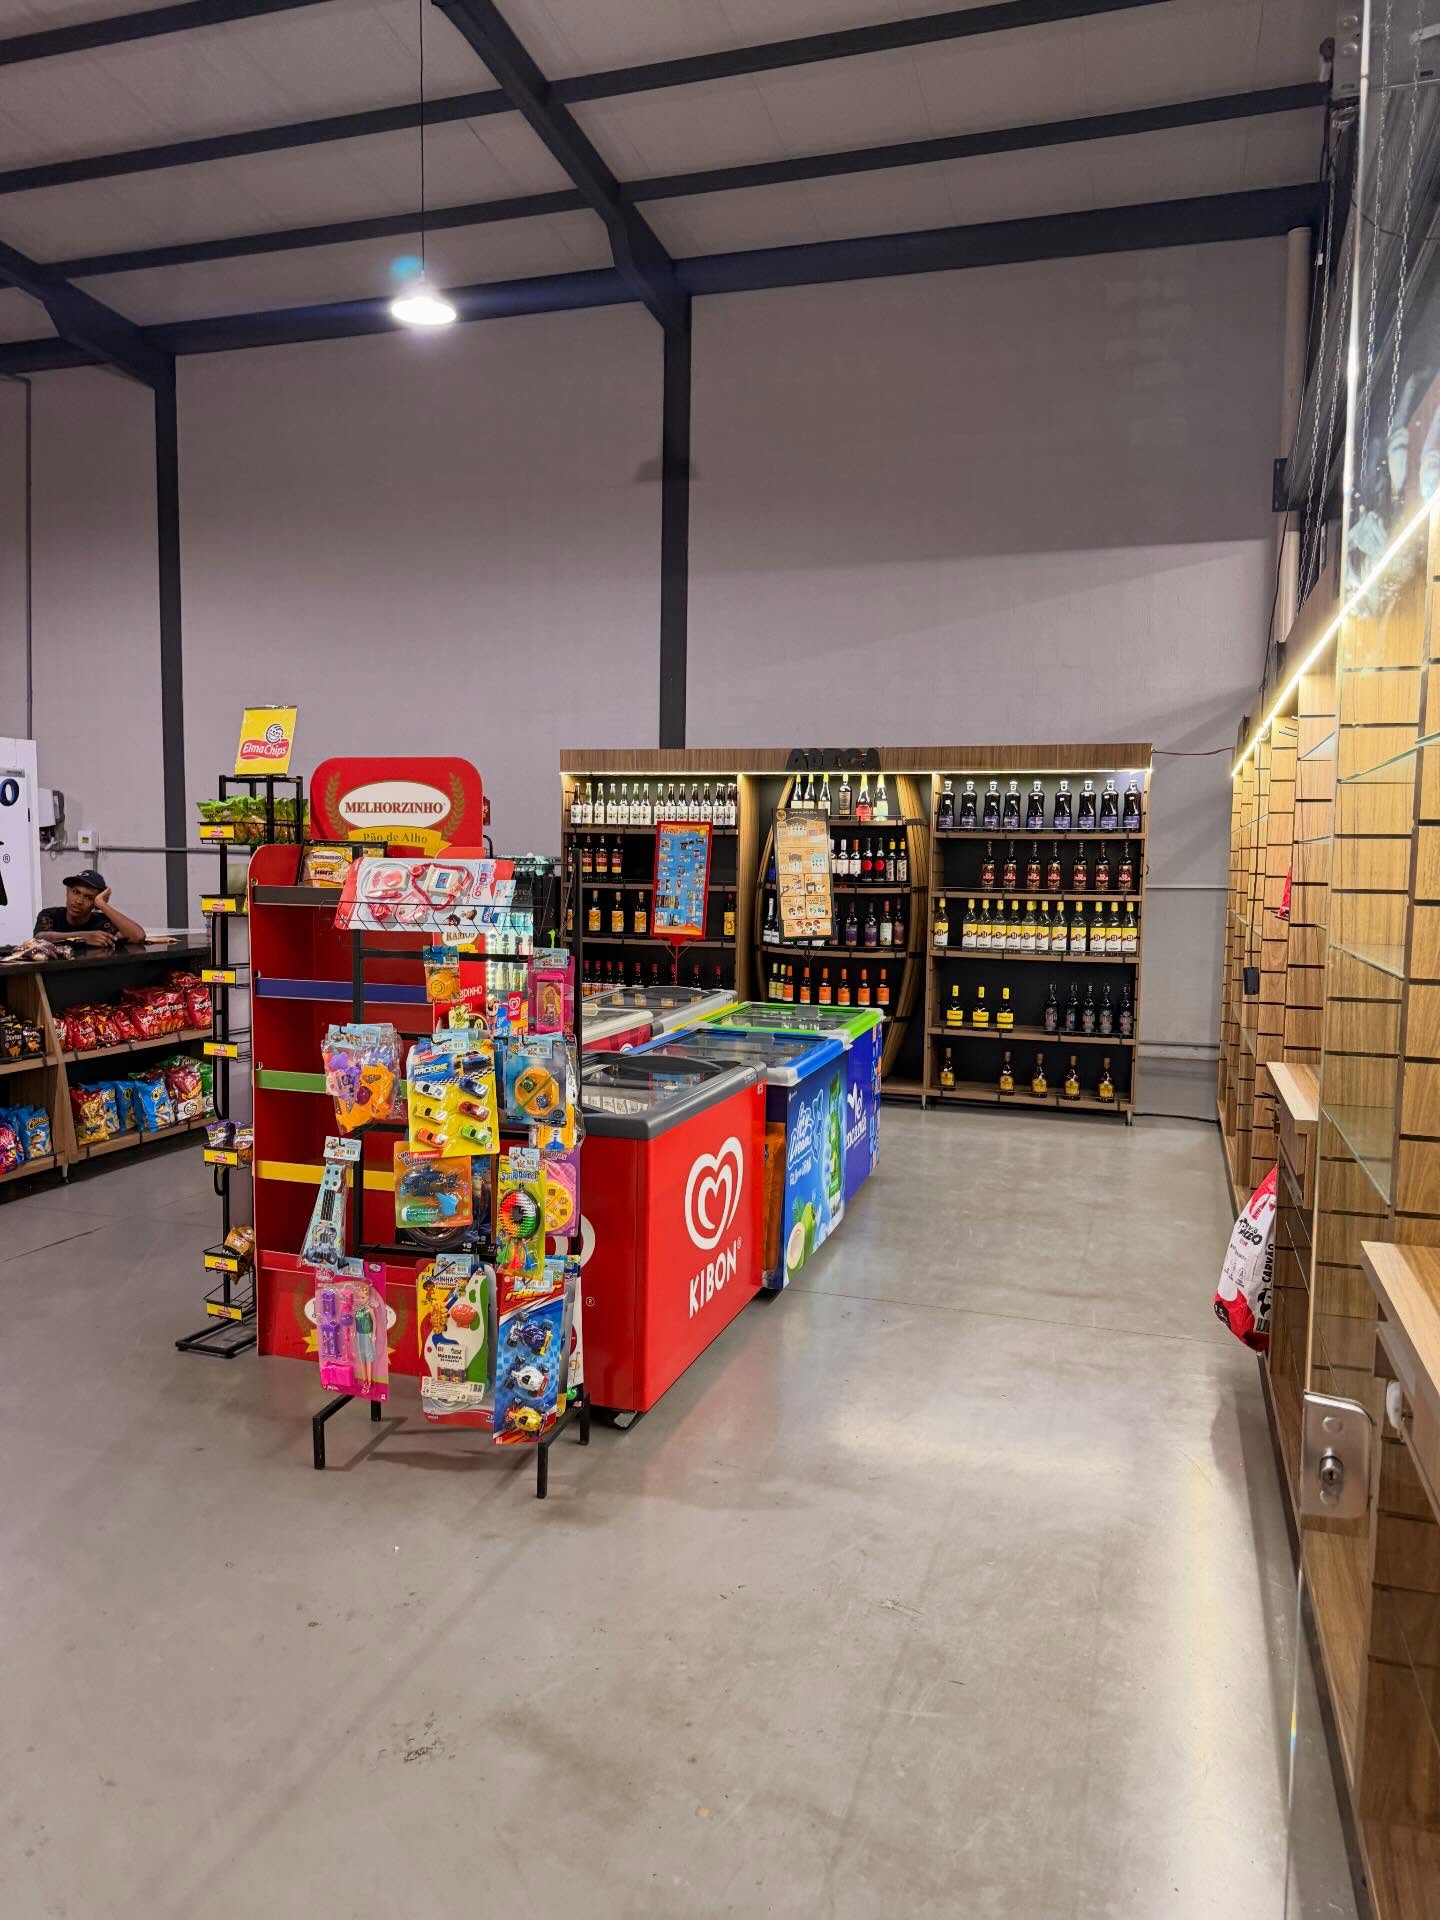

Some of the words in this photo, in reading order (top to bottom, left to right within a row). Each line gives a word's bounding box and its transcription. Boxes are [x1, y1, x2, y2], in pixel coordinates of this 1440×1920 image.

[242, 742, 264, 754] Elma
[264, 744, 287, 758] Chips
[344, 801, 444, 815] MELHORZINHO
[363, 830, 383, 842] Pão
[386, 830, 399, 842] de
[402, 831, 428, 844] Alho
[689, 1240, 737, 1319] KIBON
